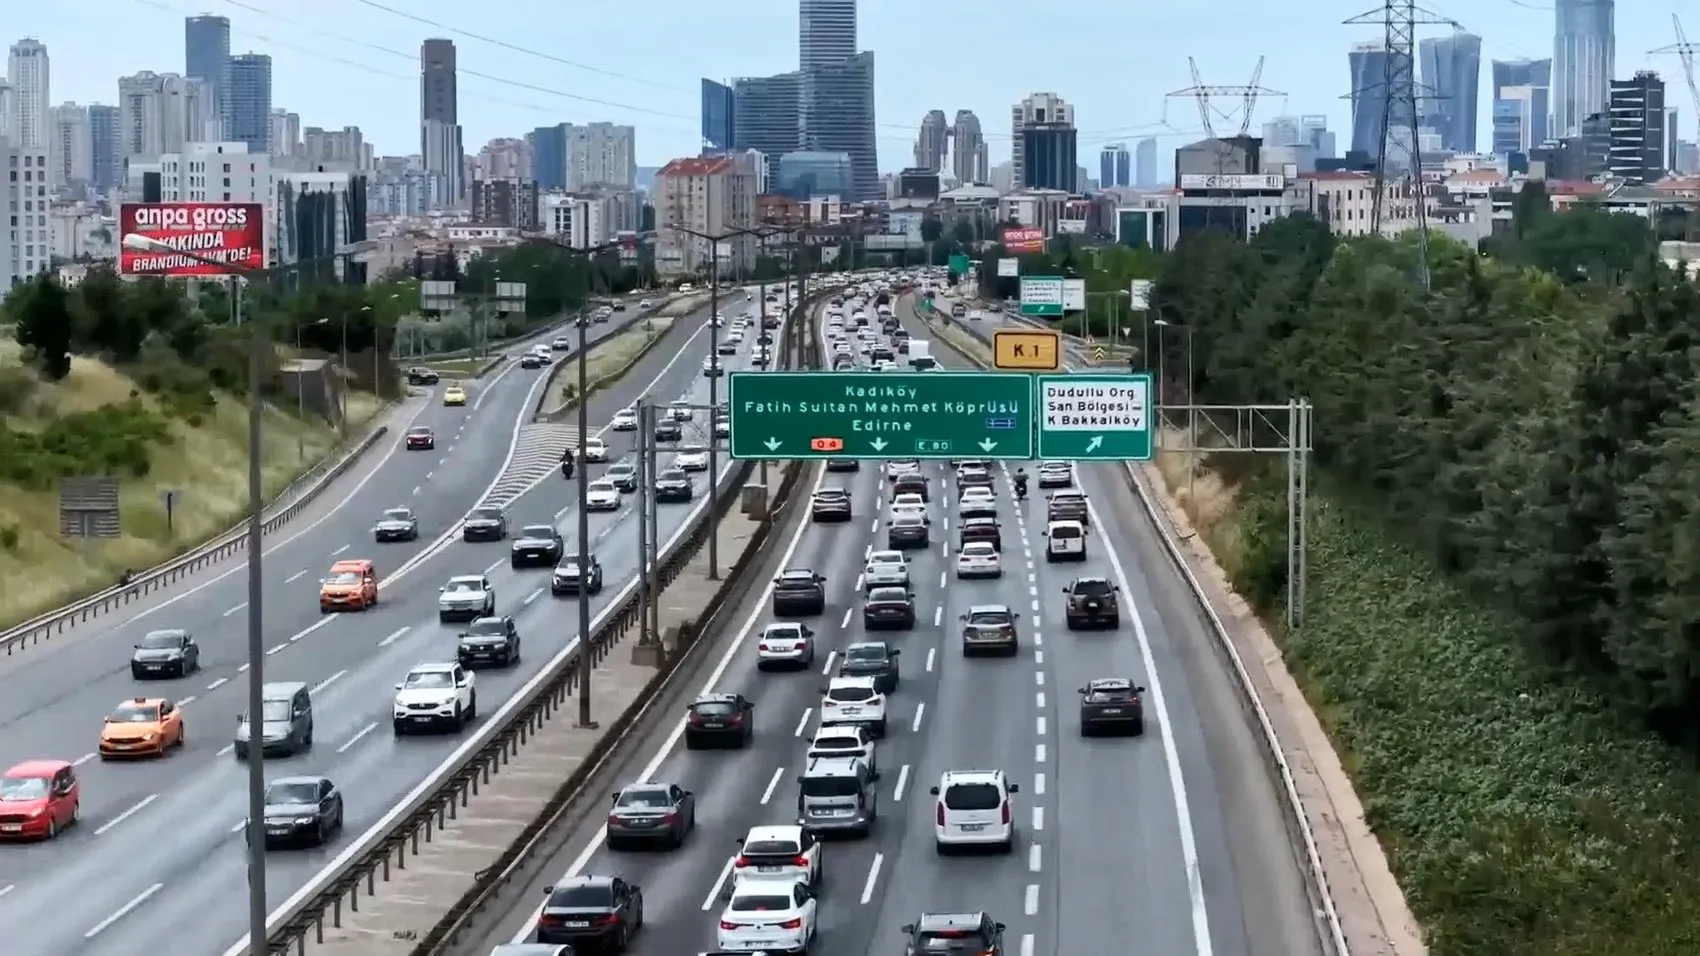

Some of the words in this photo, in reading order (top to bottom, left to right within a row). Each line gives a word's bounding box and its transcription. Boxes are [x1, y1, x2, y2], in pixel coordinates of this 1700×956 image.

[135, 207, 188, 230] anpa
[193, 207, 247, 231] gross
[845, 385, 916, 399] Kadıköy
[1047, 387, 1103, 397] Dudullu
[745, 401, 791, 412] Fatih
[799, 401, 858, 412] Sultan
[865, 401, 938, 412] Mehmet
[944, 400, 1018, 415] Köprüsü
[1078, 400, 1129, 414] Bölgesi
[852, 419, 912, 431] Edirne
